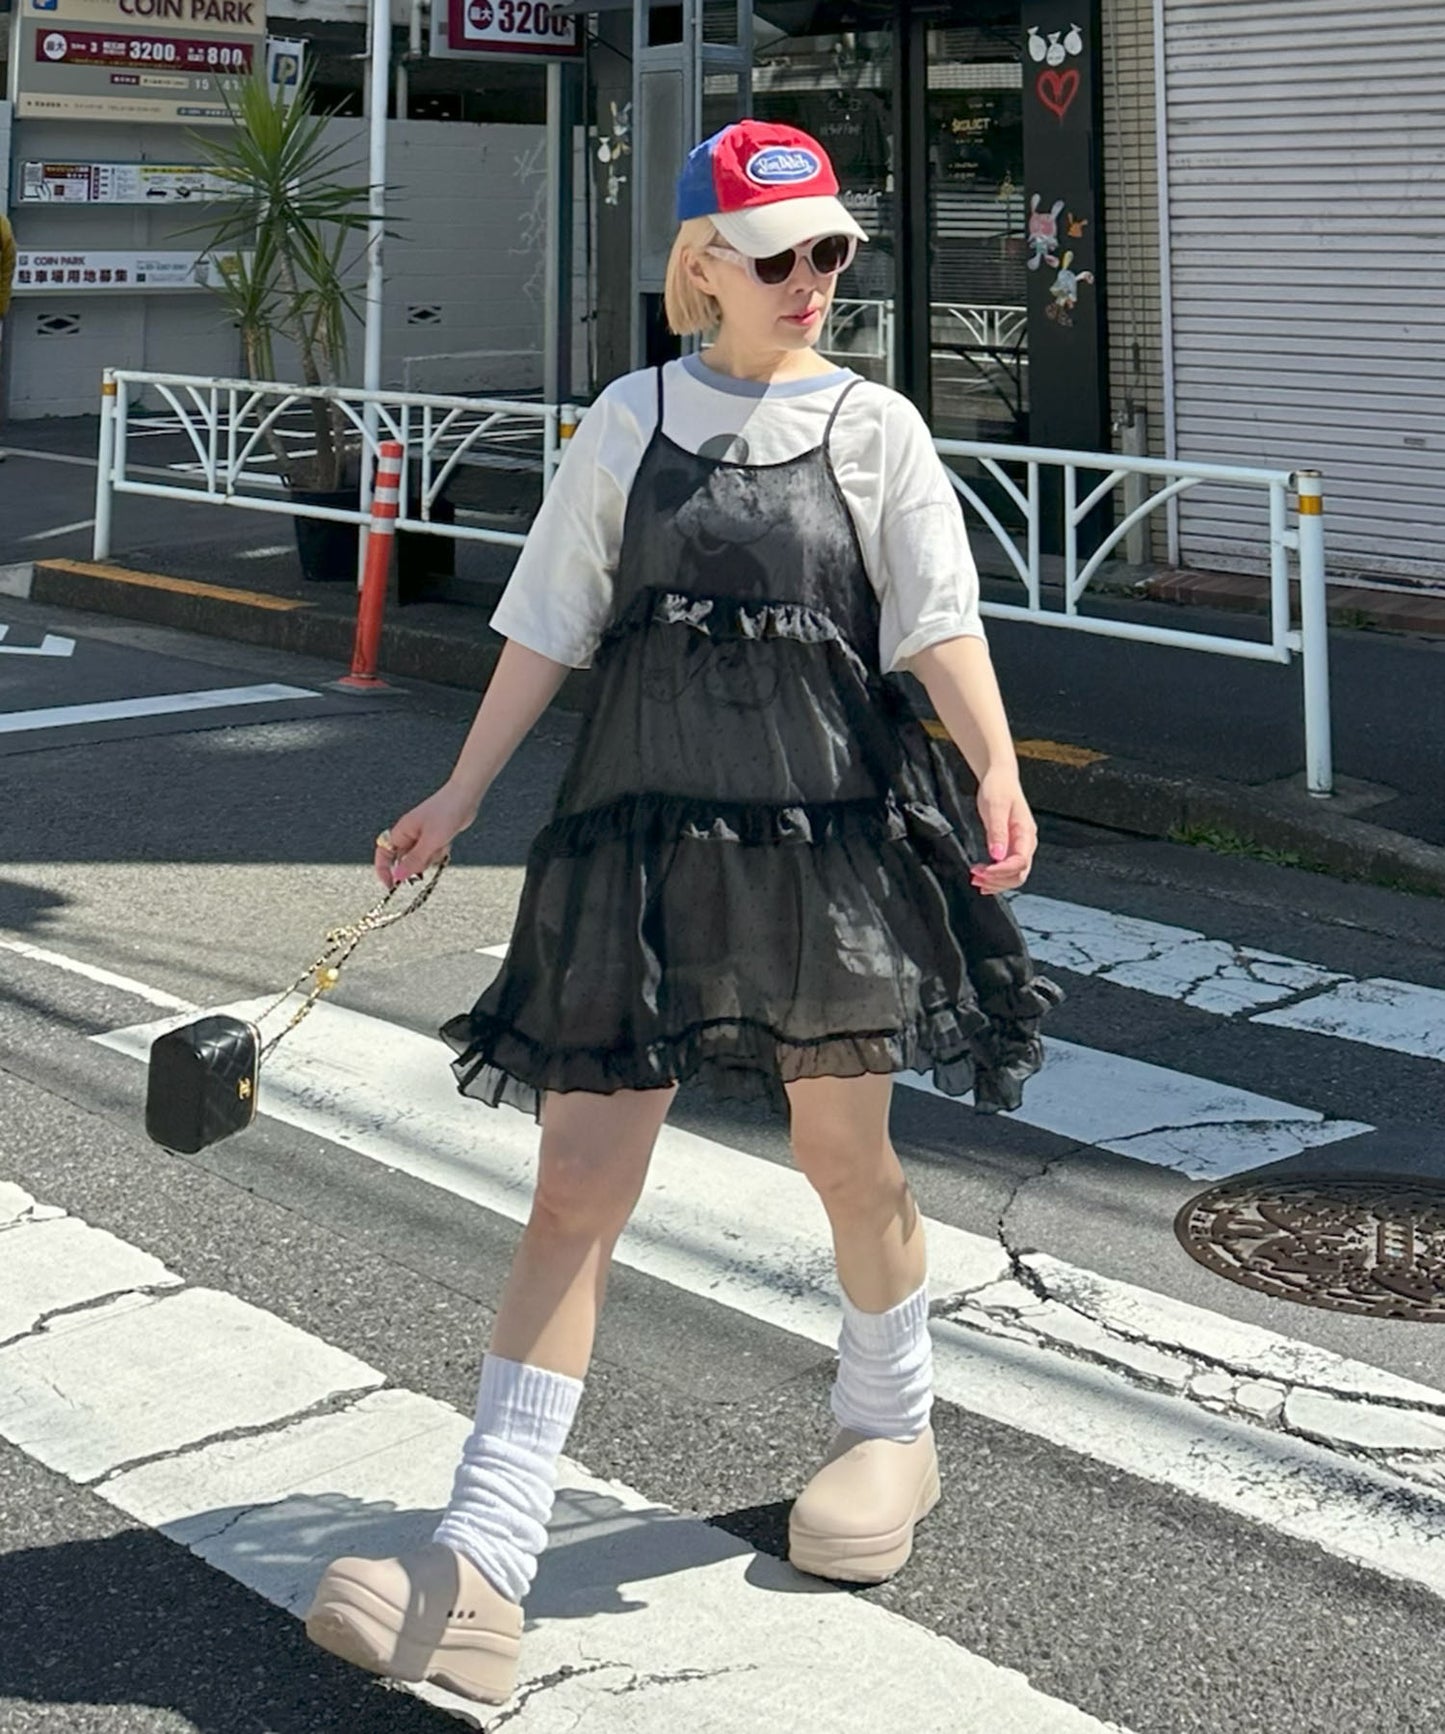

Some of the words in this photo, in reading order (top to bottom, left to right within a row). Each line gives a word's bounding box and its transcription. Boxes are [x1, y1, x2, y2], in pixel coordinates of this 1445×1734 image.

[120, 0, 183, 19] COIN
[190, 0, 255, 24] PARK
[129, 41, 175, 61] 3200
[207, 47, 243, 65] 800
[33, 256, 59, 266] COIN
[60, 256, 86, 266] PARK
